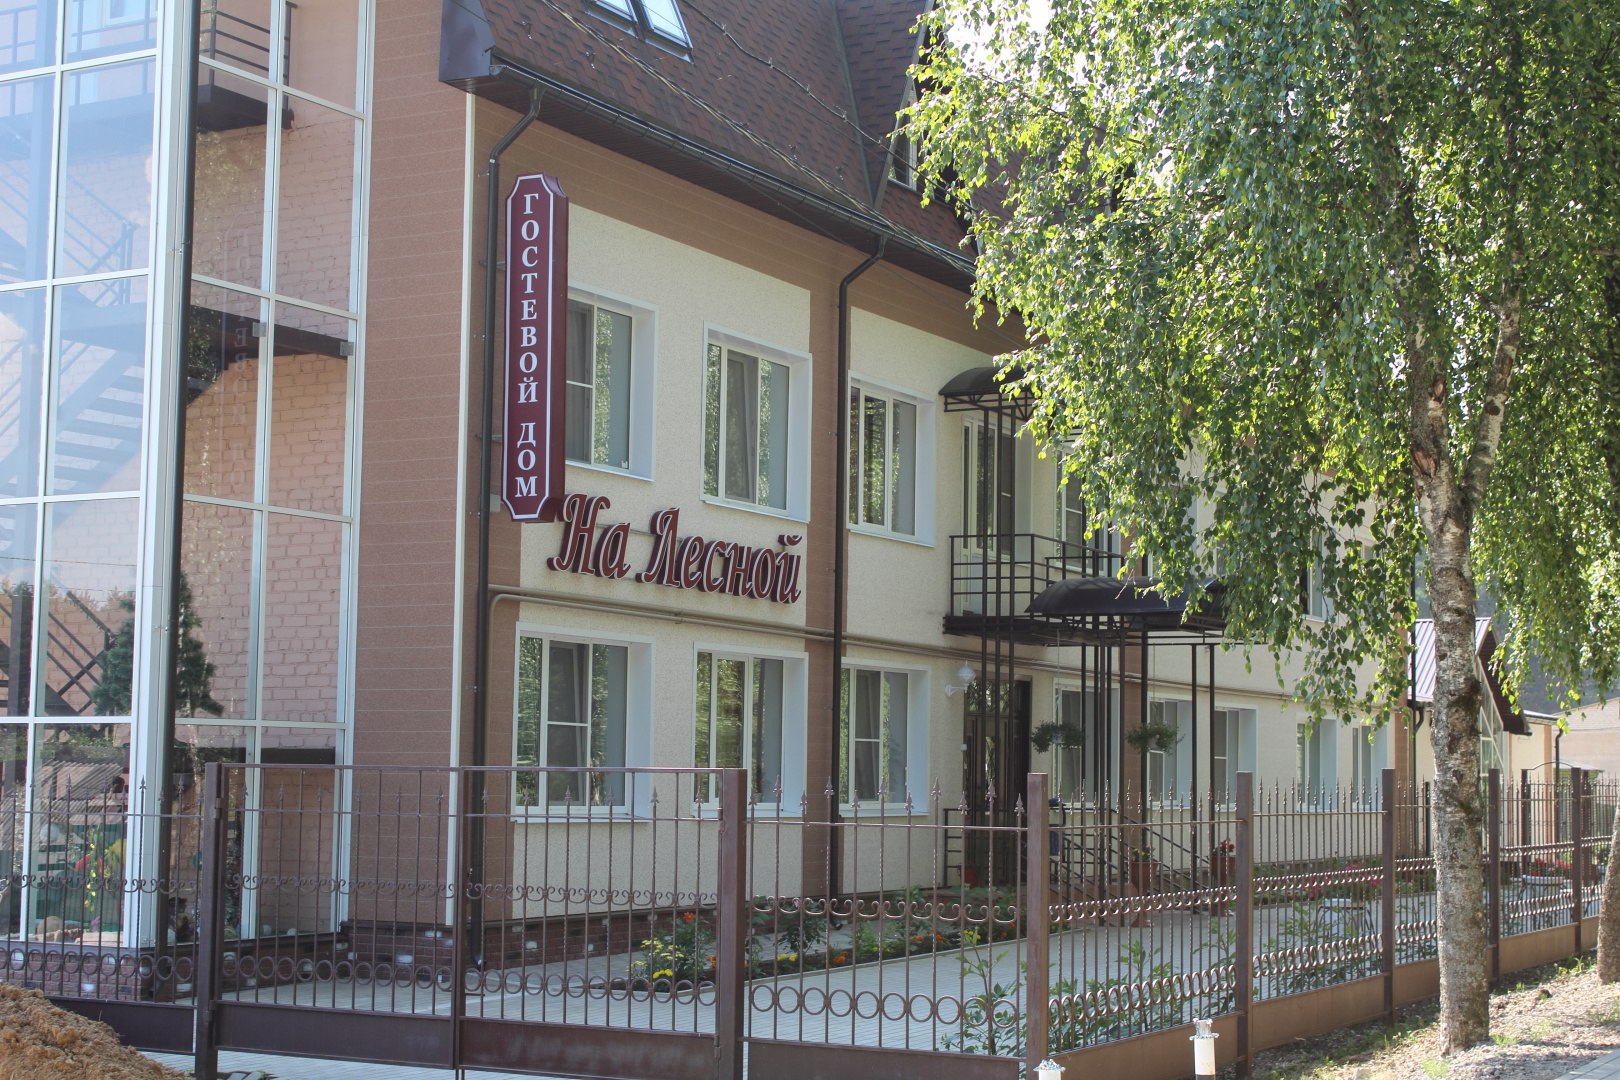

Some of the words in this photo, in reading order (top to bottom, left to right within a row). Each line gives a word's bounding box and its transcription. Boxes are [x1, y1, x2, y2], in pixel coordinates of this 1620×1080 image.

[518, 193, 540, 404] ГОСТЕВОЙ
[515, 422, 538, 497] ДОМ
[547, 493, 632, 579] На
[635, 507, 803, 604] Лесной
